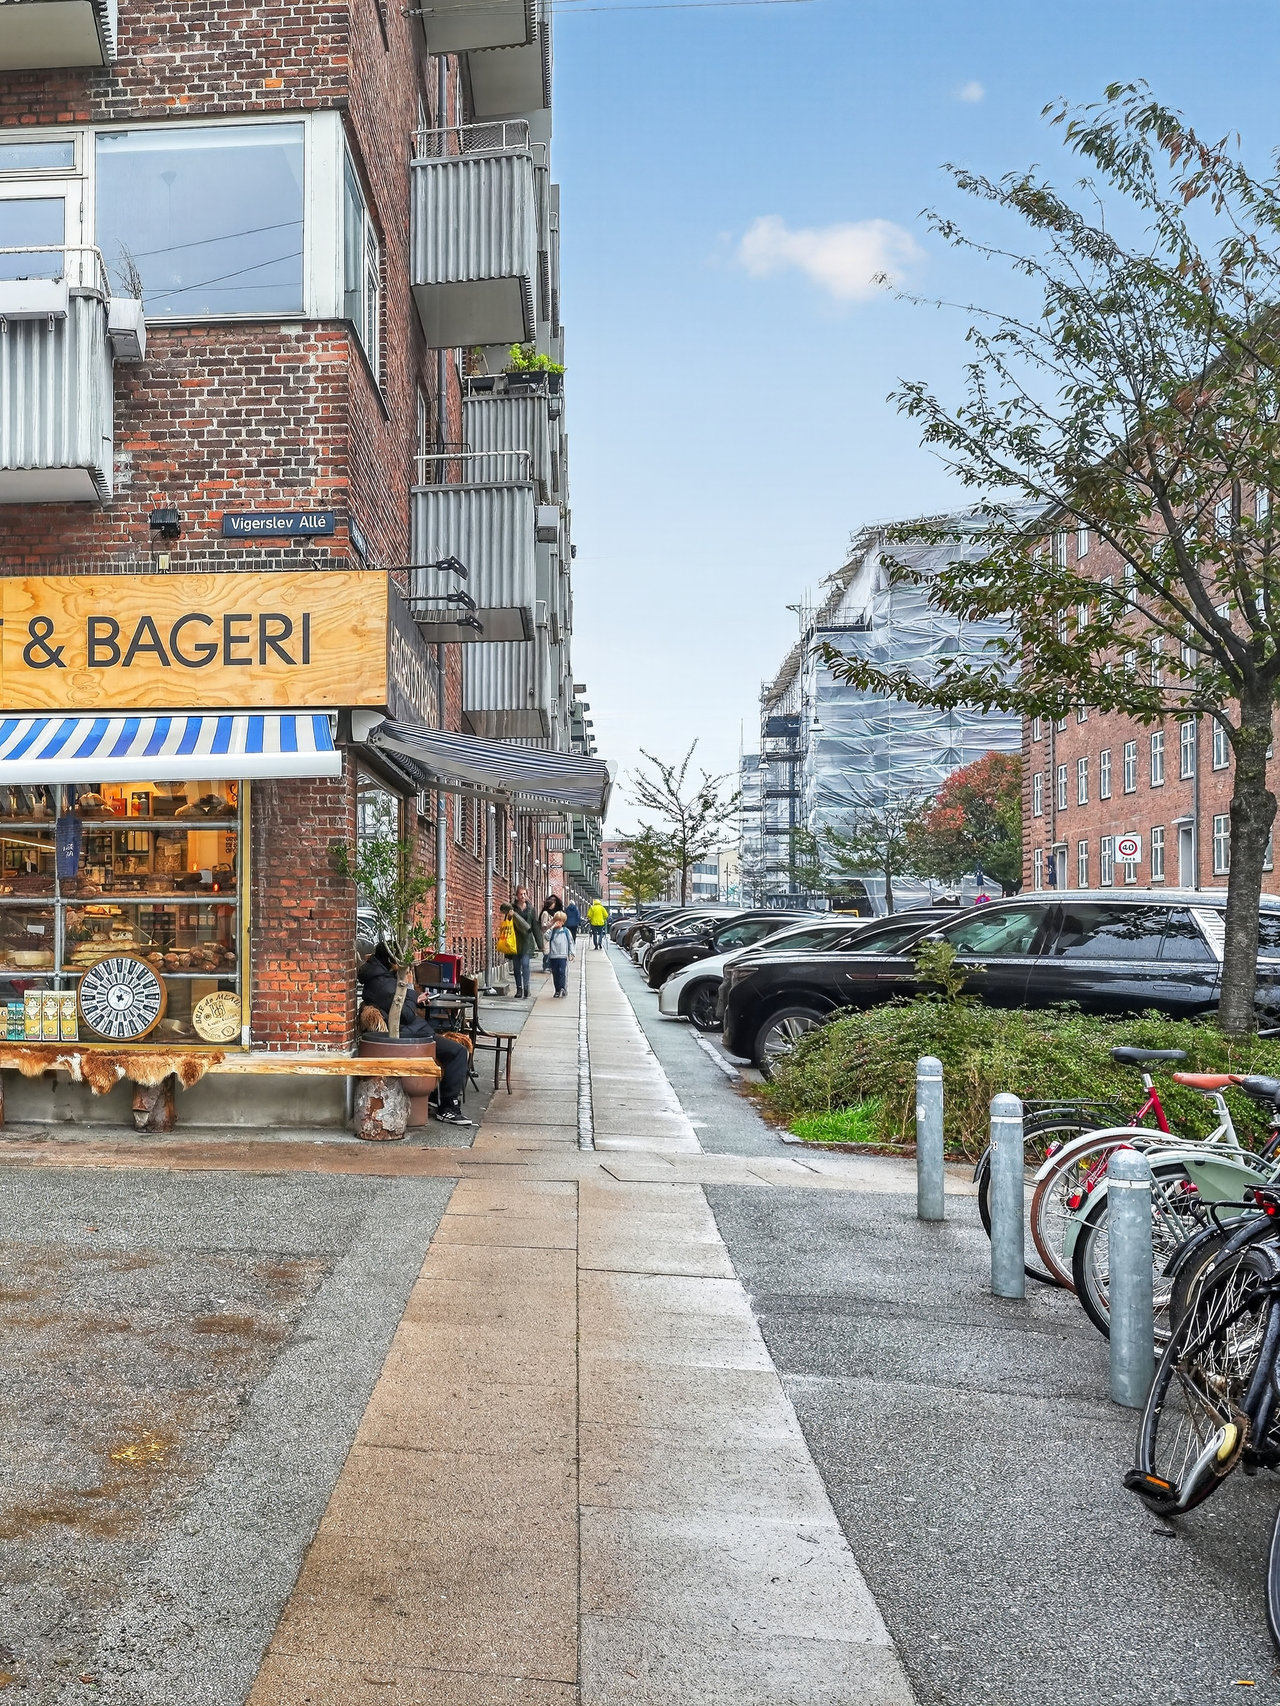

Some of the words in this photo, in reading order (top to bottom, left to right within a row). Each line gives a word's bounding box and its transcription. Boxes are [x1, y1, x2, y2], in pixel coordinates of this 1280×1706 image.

[231, 516, 294, 532] Vigerslev
[299, 515, 327, 528] Allé
[23, 615, 67, 669] &
[87, 612, 311, 668] BAGERI
[1122, 843, 1135, 852] 40
